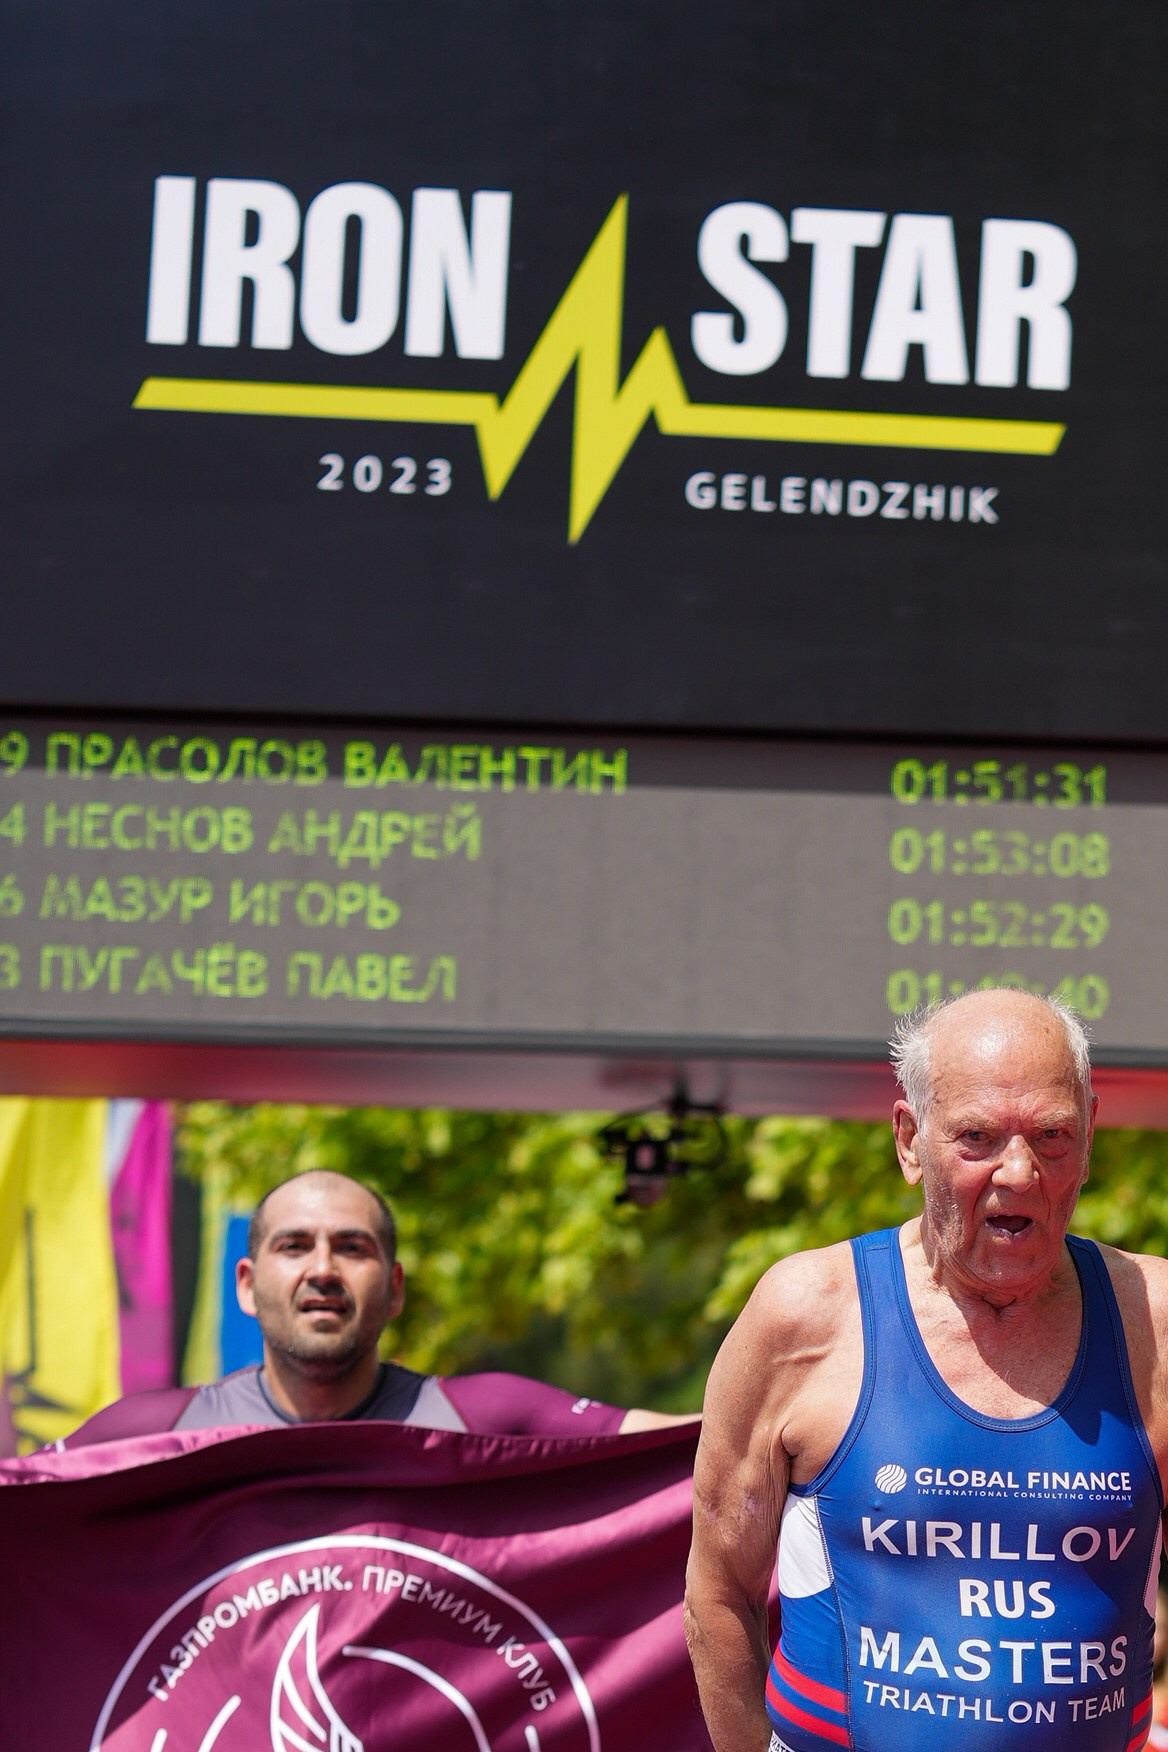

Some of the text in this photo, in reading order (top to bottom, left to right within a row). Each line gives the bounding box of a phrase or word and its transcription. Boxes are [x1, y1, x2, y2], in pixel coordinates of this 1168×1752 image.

[146, 175, 1078, 390] IRON STAR
[317, 454, 1000, 524] 2023 GELENDZHIK
[46, 733, 328, 787] ПРАСОЛОВ
[344, 741, 627, 794] ВАЛЕНТИН
[890, 759, 1107, 809] 01:51:31
[43, 803, 254, 853] НЕСНОВ
[268, 801, 481, 868] АНДРЕЙ
[889, 828, 1110, 879] 01:53:08
[39, 874, 212, 923] МАЗУР
[230, 879, 400, 930] ИГОРЬ
[888, 898, 1109, 949] 01:52:29
[40, 942, 268, 997] ПУГАЧЁВ
[288, 951, 457, 1002] ПАВЕЛ
[886, 968, 1110, 1020] 01::40
[915, 1467, 1131, 1491] GLOBAL FINANCE
[918, 1489, 1008, 1498] INTERNATIONAL
[1014, 1491, 1083, 1500] CONSULTING
[862, 1517, 1136, 1561] KIRILLOV
[959, 1579, 1055, 1619] RUS
[362, 1565, 502, 1643] ПРЕМИУМ
[496, 1634, 556, 1712] КЛУБ
[858, 1627, 1128, 1685] MASTERS
[863, 1681, 1127, 1724] TRIATHLON TEAM
